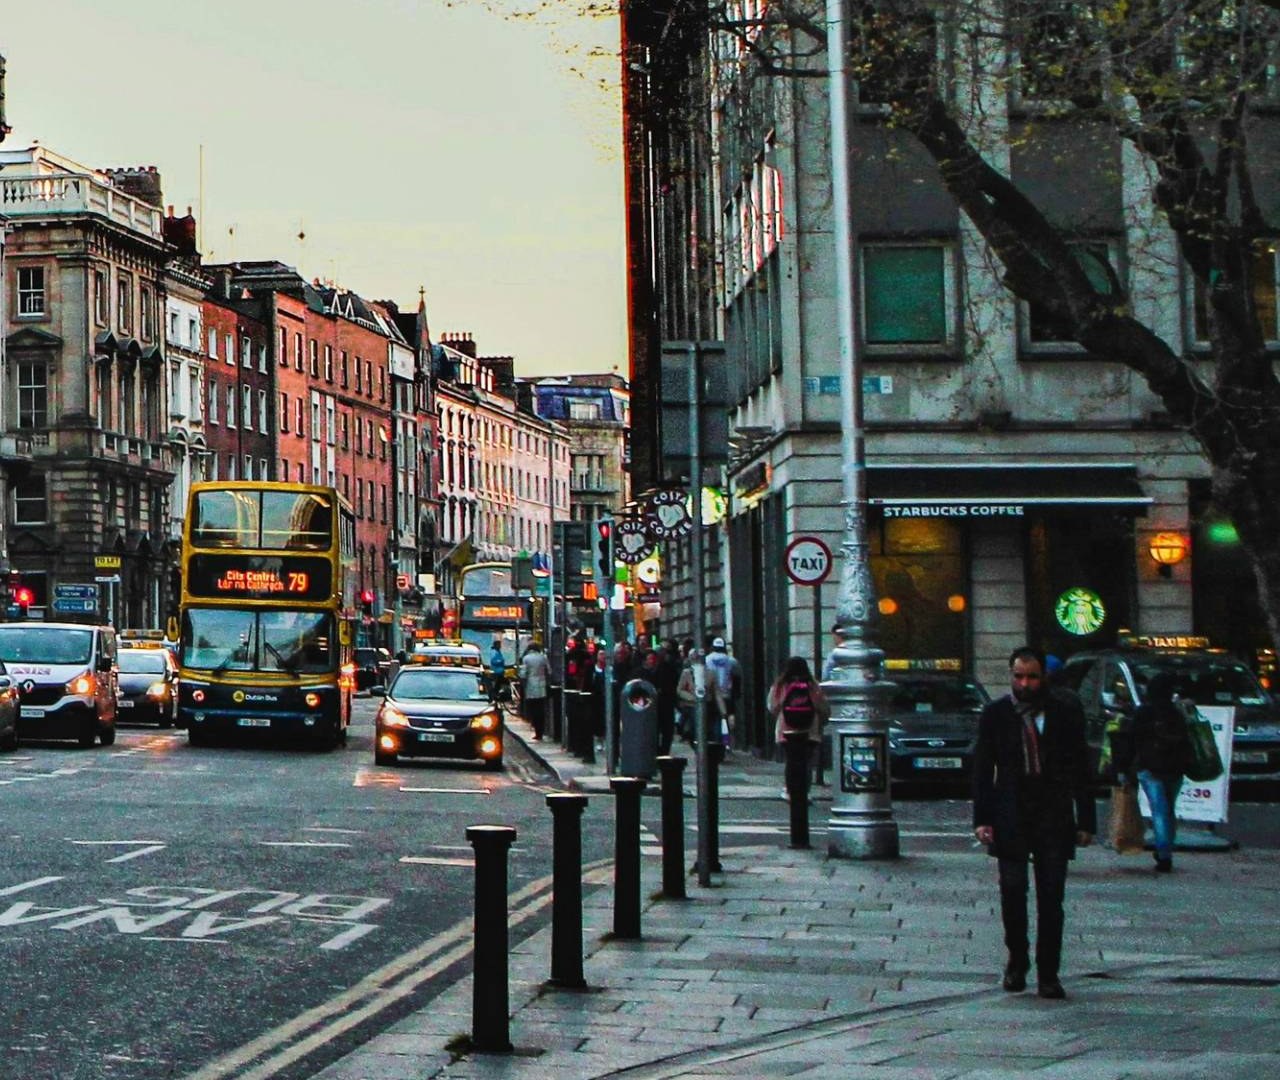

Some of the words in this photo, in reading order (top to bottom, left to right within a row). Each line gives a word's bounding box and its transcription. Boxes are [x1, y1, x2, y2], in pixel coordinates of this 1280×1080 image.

[653, 491, 688, 506] COSTA
[883, 506, 967, 517] STARBUCKS
[970, 505, 1024, 516] COFFEE
[617, 521, 647, 534] COSTA
[649, 520, 693, 538] COFFEE
[615, 547, 652, 562] COFFEE
[791, 558, 823, 570] TAXI
[246, 571, 275, 581] Centre
[288, 572, 307, 591] 79
[97, 885, 392, 920] BUS
